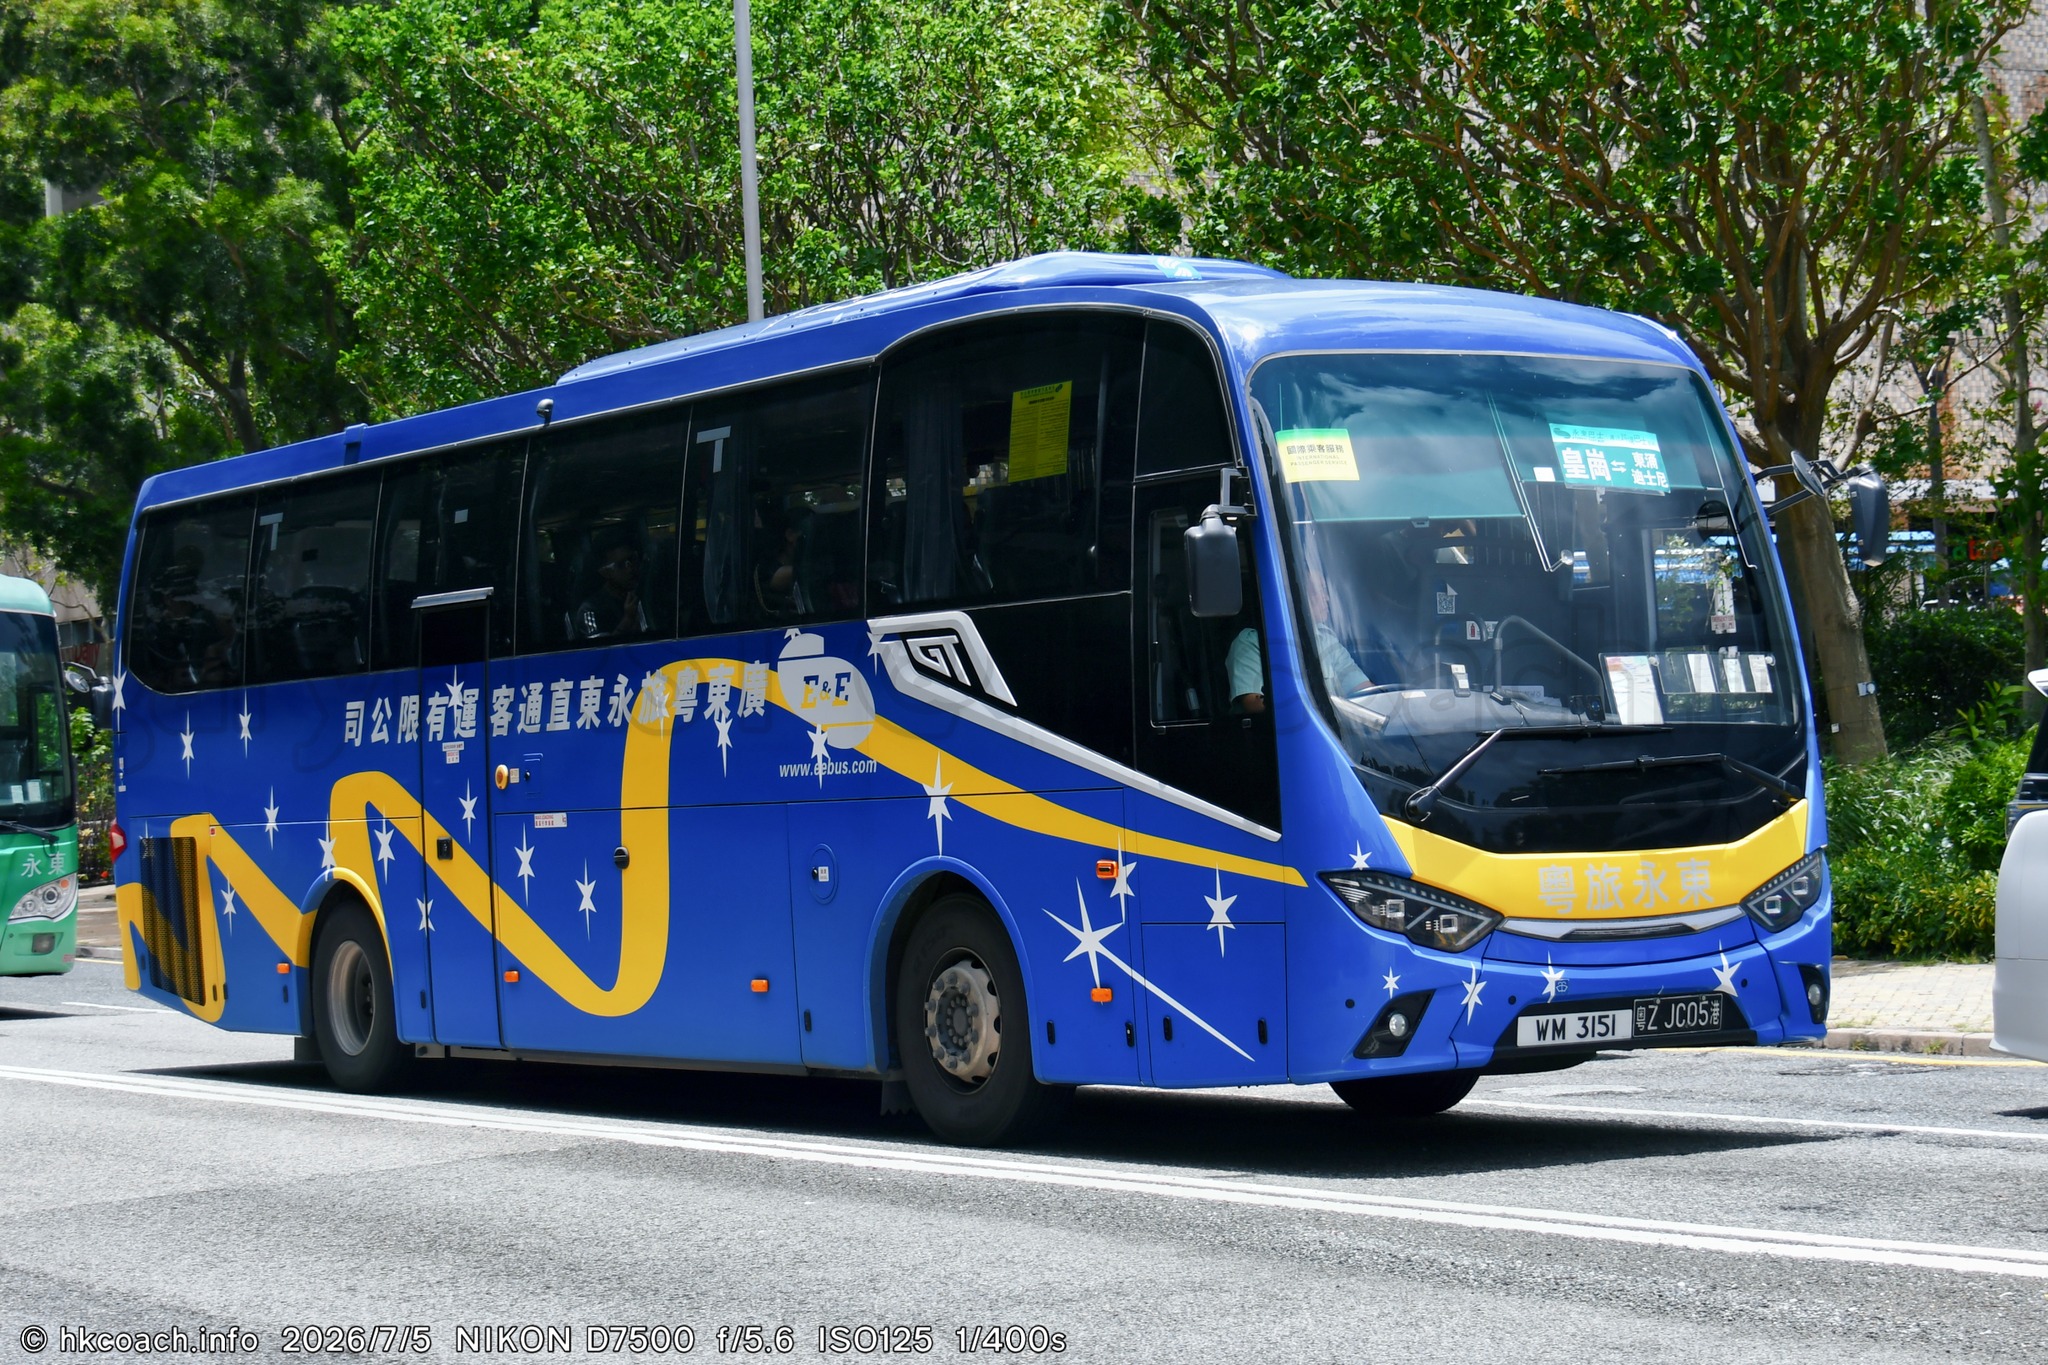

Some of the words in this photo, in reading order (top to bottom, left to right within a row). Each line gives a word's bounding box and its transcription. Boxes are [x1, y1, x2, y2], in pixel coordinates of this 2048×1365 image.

[1561, 447, 1612, 482] 皇崗
[1631, 451, 1659, 470] 東涌
[1631, 468, 1669, 489] 迪士尼
[800, 671, 852, 710] E&E
[779, 758, 878, 778] www.eebus.com
[21, 850, 67, 878] 永東
[1536, 1017, 1567, 1042] WM
[1576, 1013, 1617, 1039] 3151
